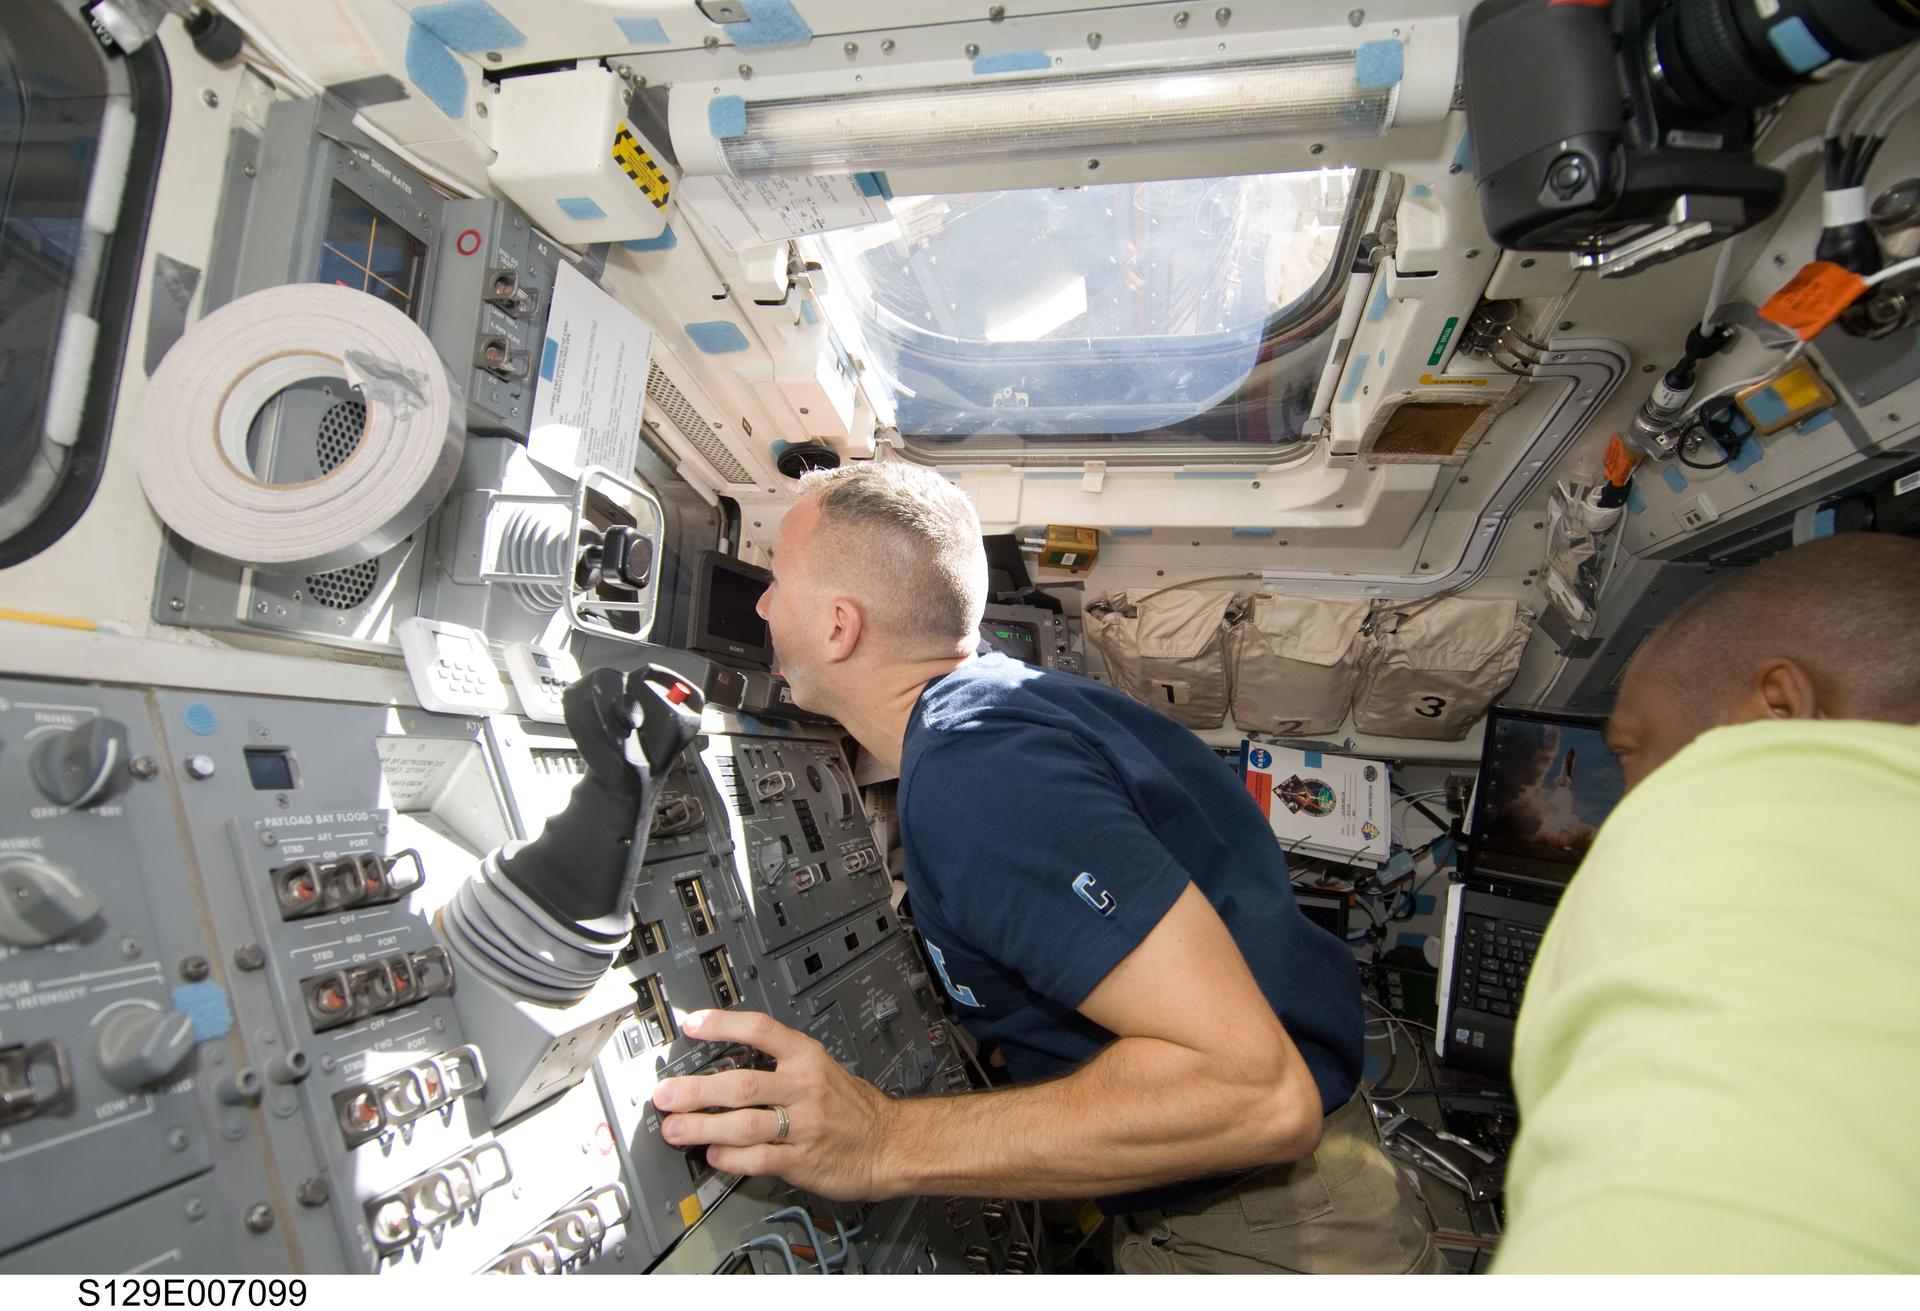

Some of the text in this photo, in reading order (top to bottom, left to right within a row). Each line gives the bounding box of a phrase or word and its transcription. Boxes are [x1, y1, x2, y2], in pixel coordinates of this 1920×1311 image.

[537, 242, 548, 256] A2
[1161, 684, 1174, 704] 1
[1415, 696, 1447, 718] 3
[1257, 750, 1265, 768] NASA
[264, 812, 369, 828] PAYLOAD BAY FLOOD
[317, 833, 332, 842] AFT
[349, 839, 370, 848] PORT
[283, 845, 305, 855] STBD
[323, 851, 338, 859] ON
[339, 914, 357, 925] OFF
[345, 935, 363, 945] MID
[377, 936, 398, 947] PORT
[311, 950, 335, 963] STBD
[352, 953, 367, 963] ON
[16, 986, 88, 1010] INTENSITY
[370, 1019, 386, 1031] OFF
[407, 1037, 427, 1050] PORT
[95, 1099, 127, 1119] LOW
